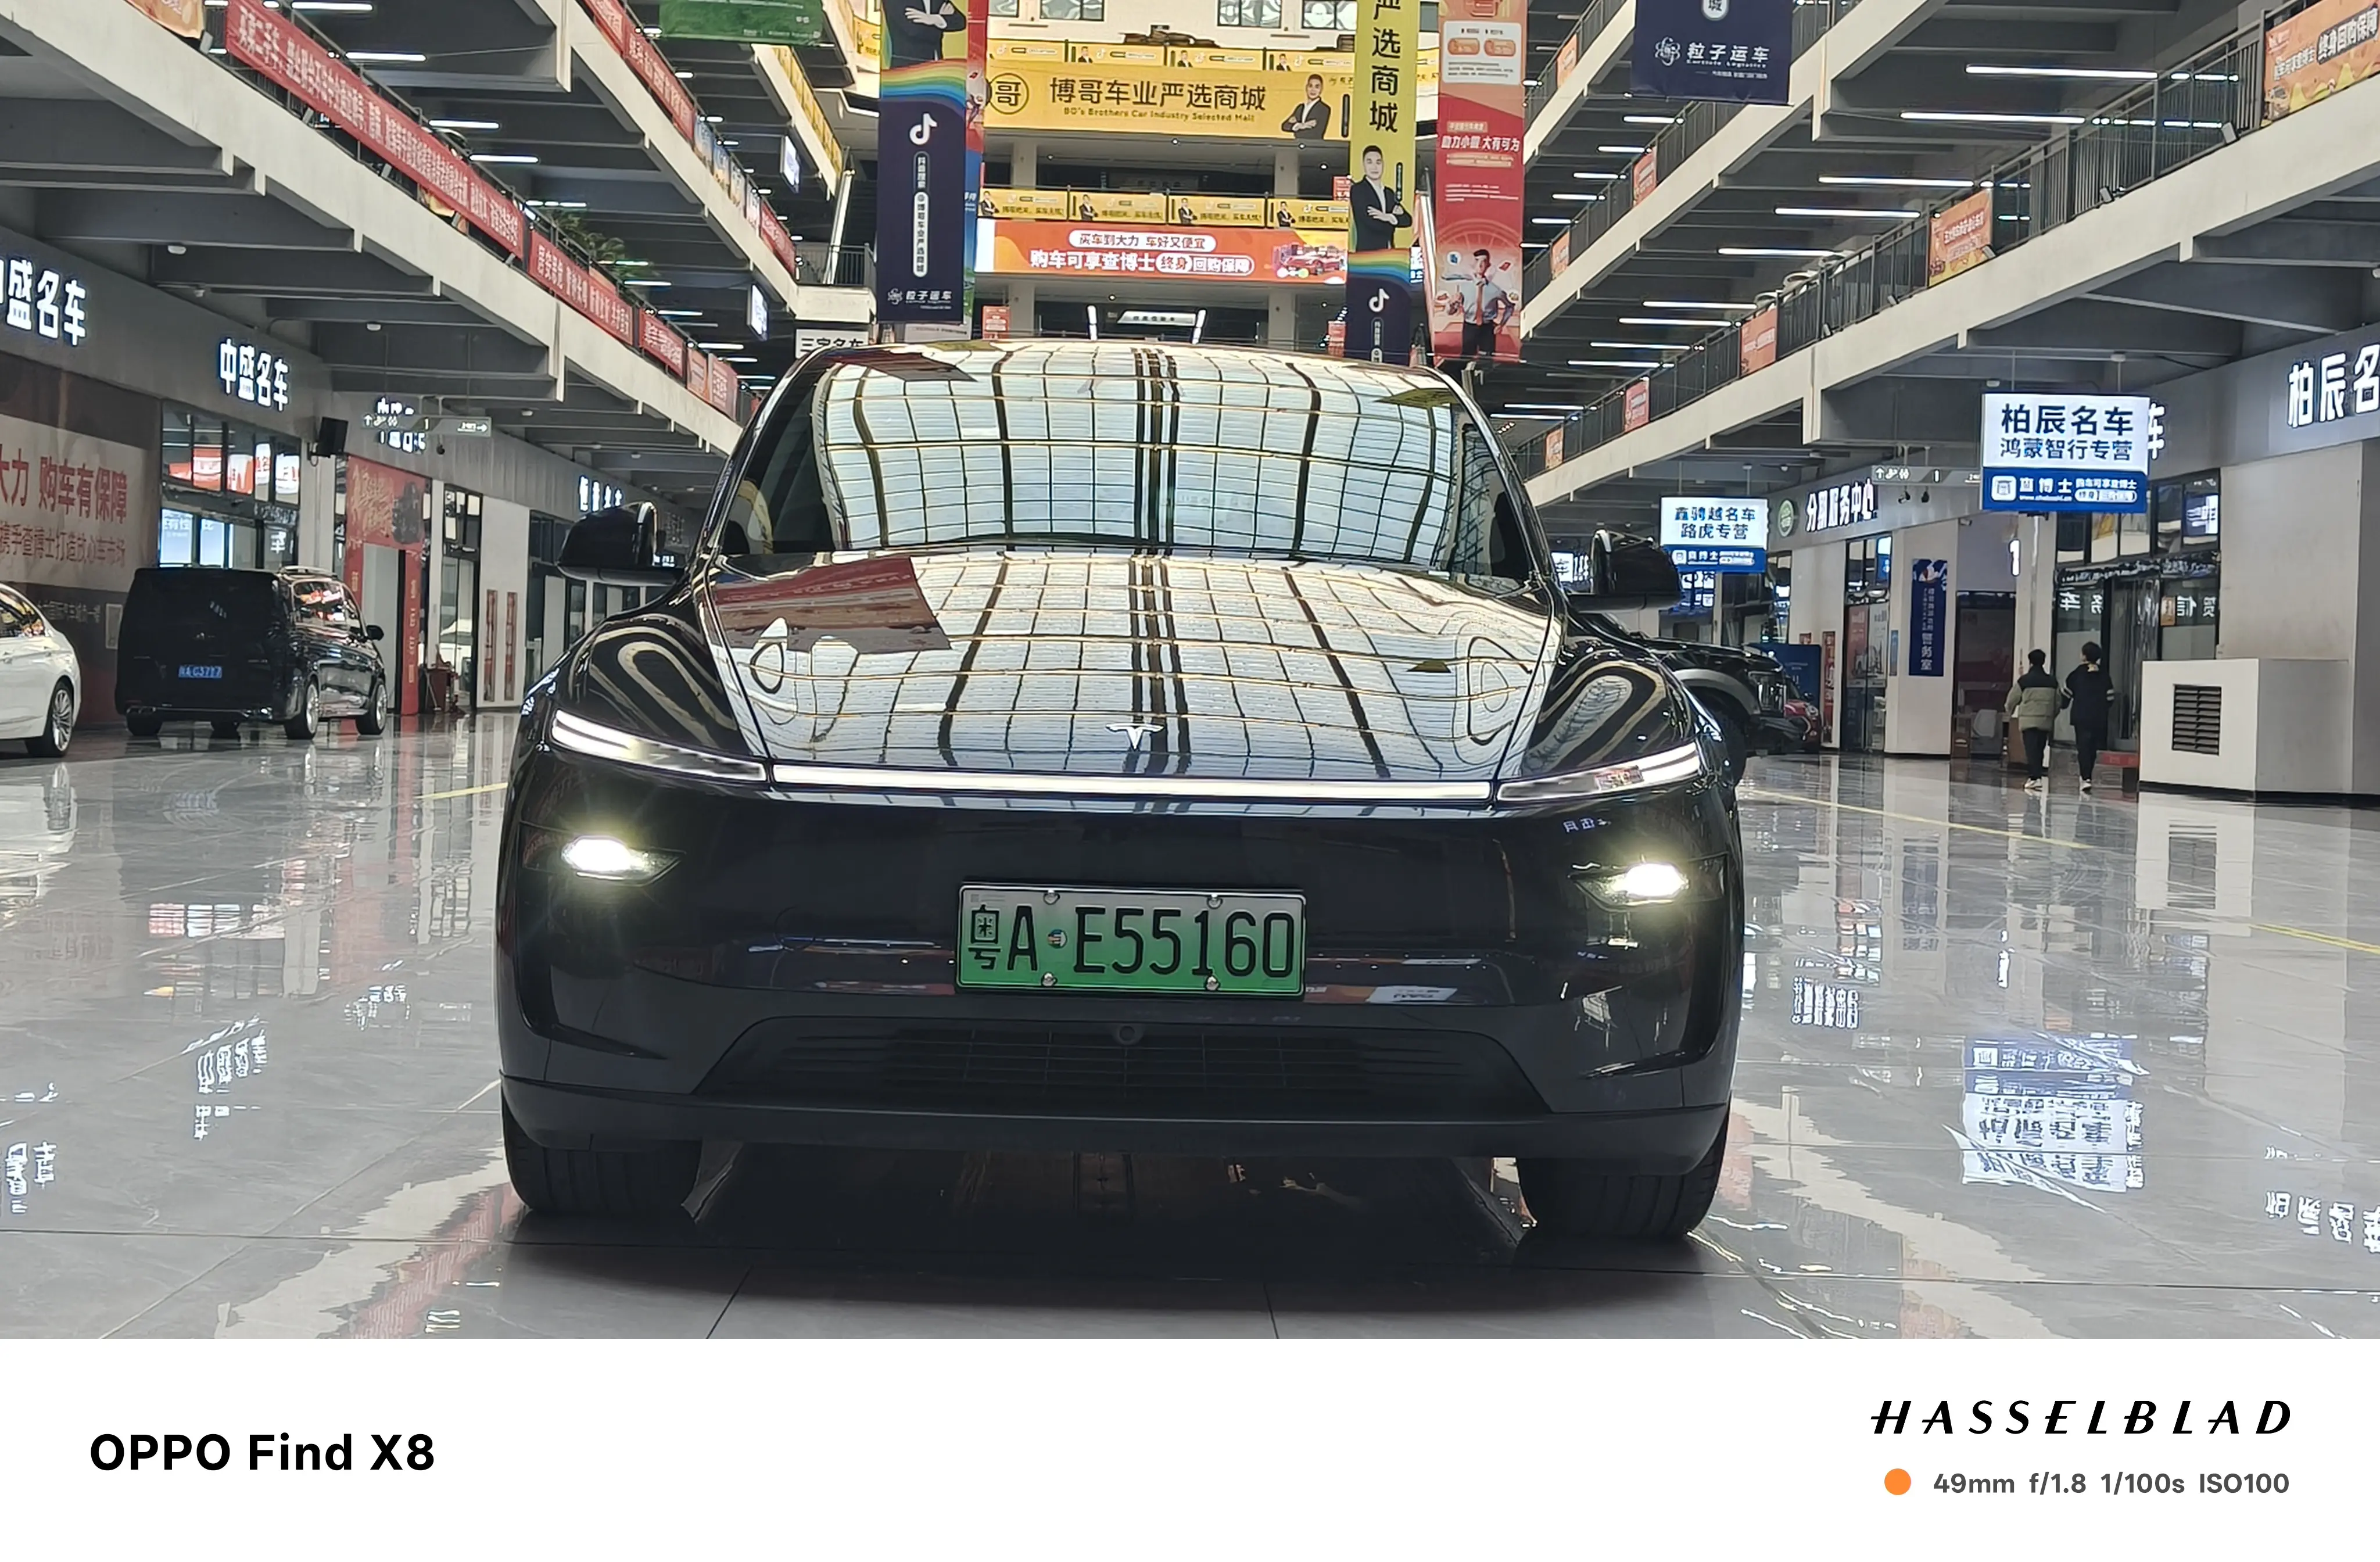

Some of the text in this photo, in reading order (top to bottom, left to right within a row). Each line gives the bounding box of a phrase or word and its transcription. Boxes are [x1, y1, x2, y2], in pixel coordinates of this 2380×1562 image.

[1687, 42, 1770, 63] 粒子运车
[1049, 77, 1267, 111] 博哥车业严选商城
[1088, 108, 1129, 117] Brothers
[1132, 109, 1148, 117] Car
[1150, 110, 1189, 121] Industry
[1192, 112, 1232, 121] Selected
[1235, 114, 1255, 122] Mall
[1482, 136, 1521, 152] 大有可为
[1079, 233, 1206, 250] 买车到大力 车好又便宜
[219, 338, 290, 410] 中盛名车
[2288, 343, 2380, 429] 柏辰名
[2000, 403, 2134, 437] 柏辰名车
[1999, 438, 2134, 461] 鸿蒙智行专营
[38, 455, 128, 524] 购车有保障
[1680, 523, 1748, 540] 路虎专营
[1073, 905, 1295, 978] E55160
